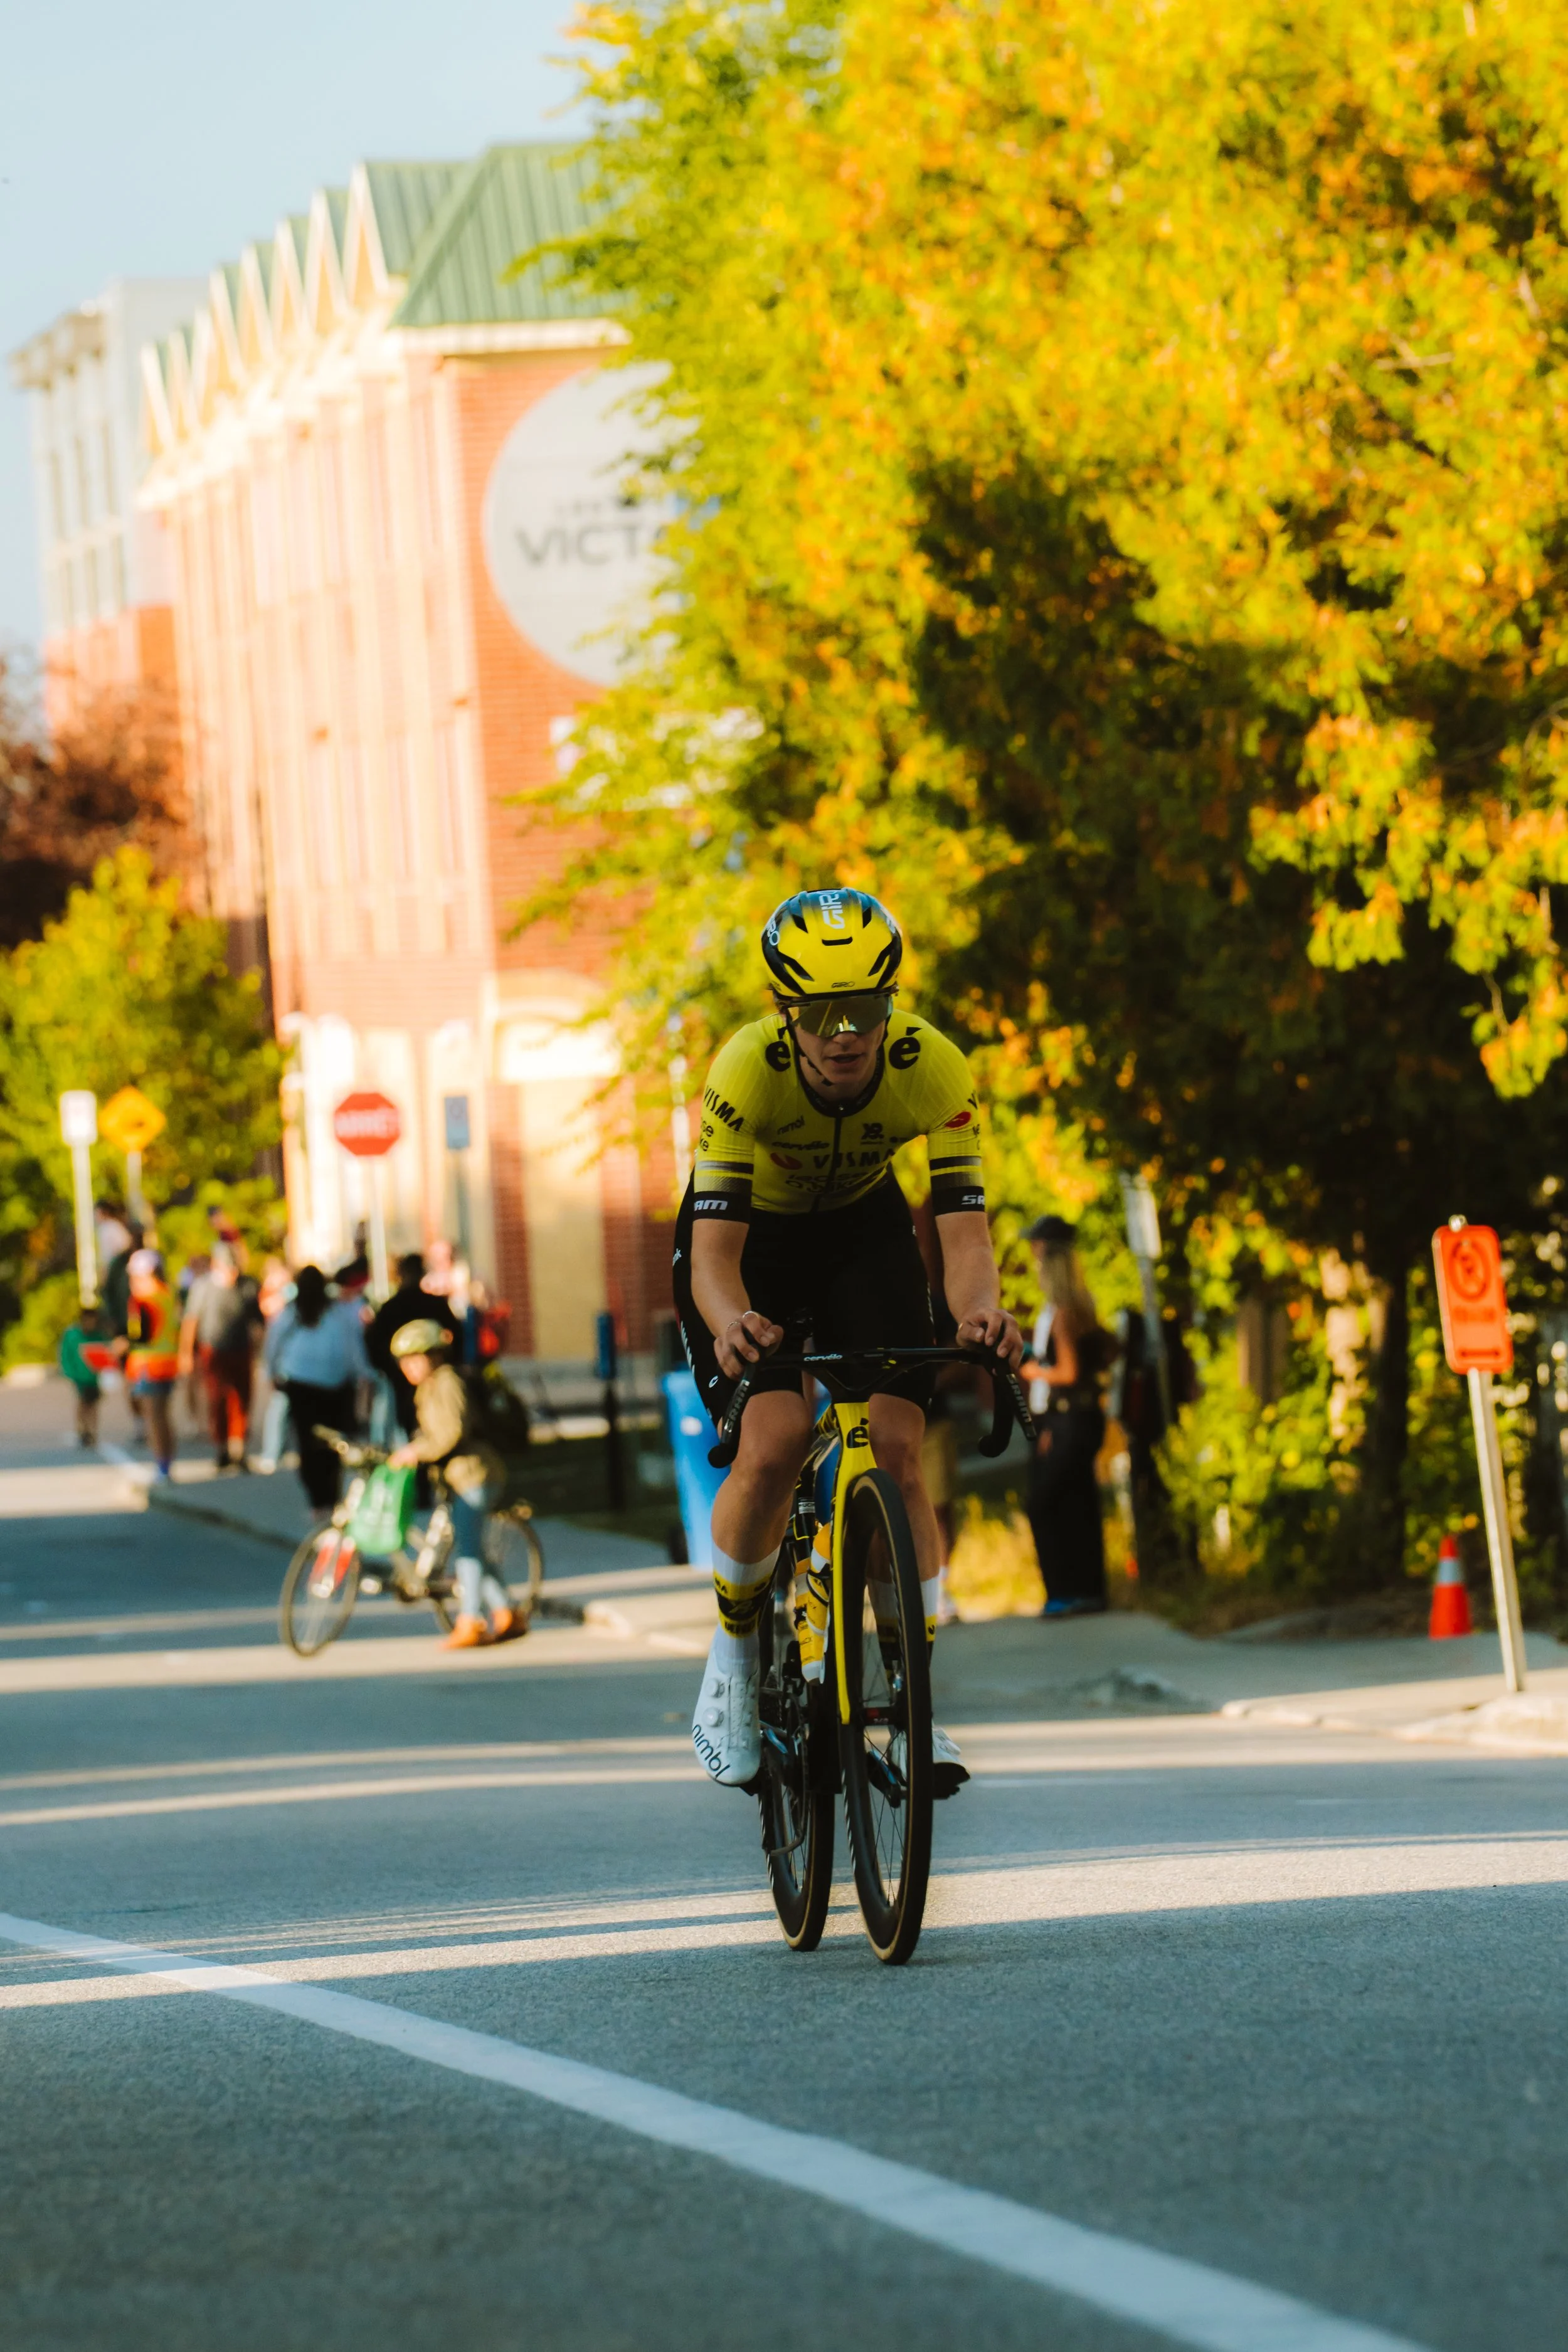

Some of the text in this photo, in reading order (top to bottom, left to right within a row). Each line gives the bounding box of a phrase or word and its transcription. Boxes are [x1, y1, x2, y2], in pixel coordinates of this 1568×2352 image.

[513, 522, 666, 567] VICT
[703, 1085, 745, 1132] VISMA
[813, 1148, 894, 1169] VISMA
[803, 1353, 844, 1362] cervélo
[692, 1724, 731, 1778] nimbl
